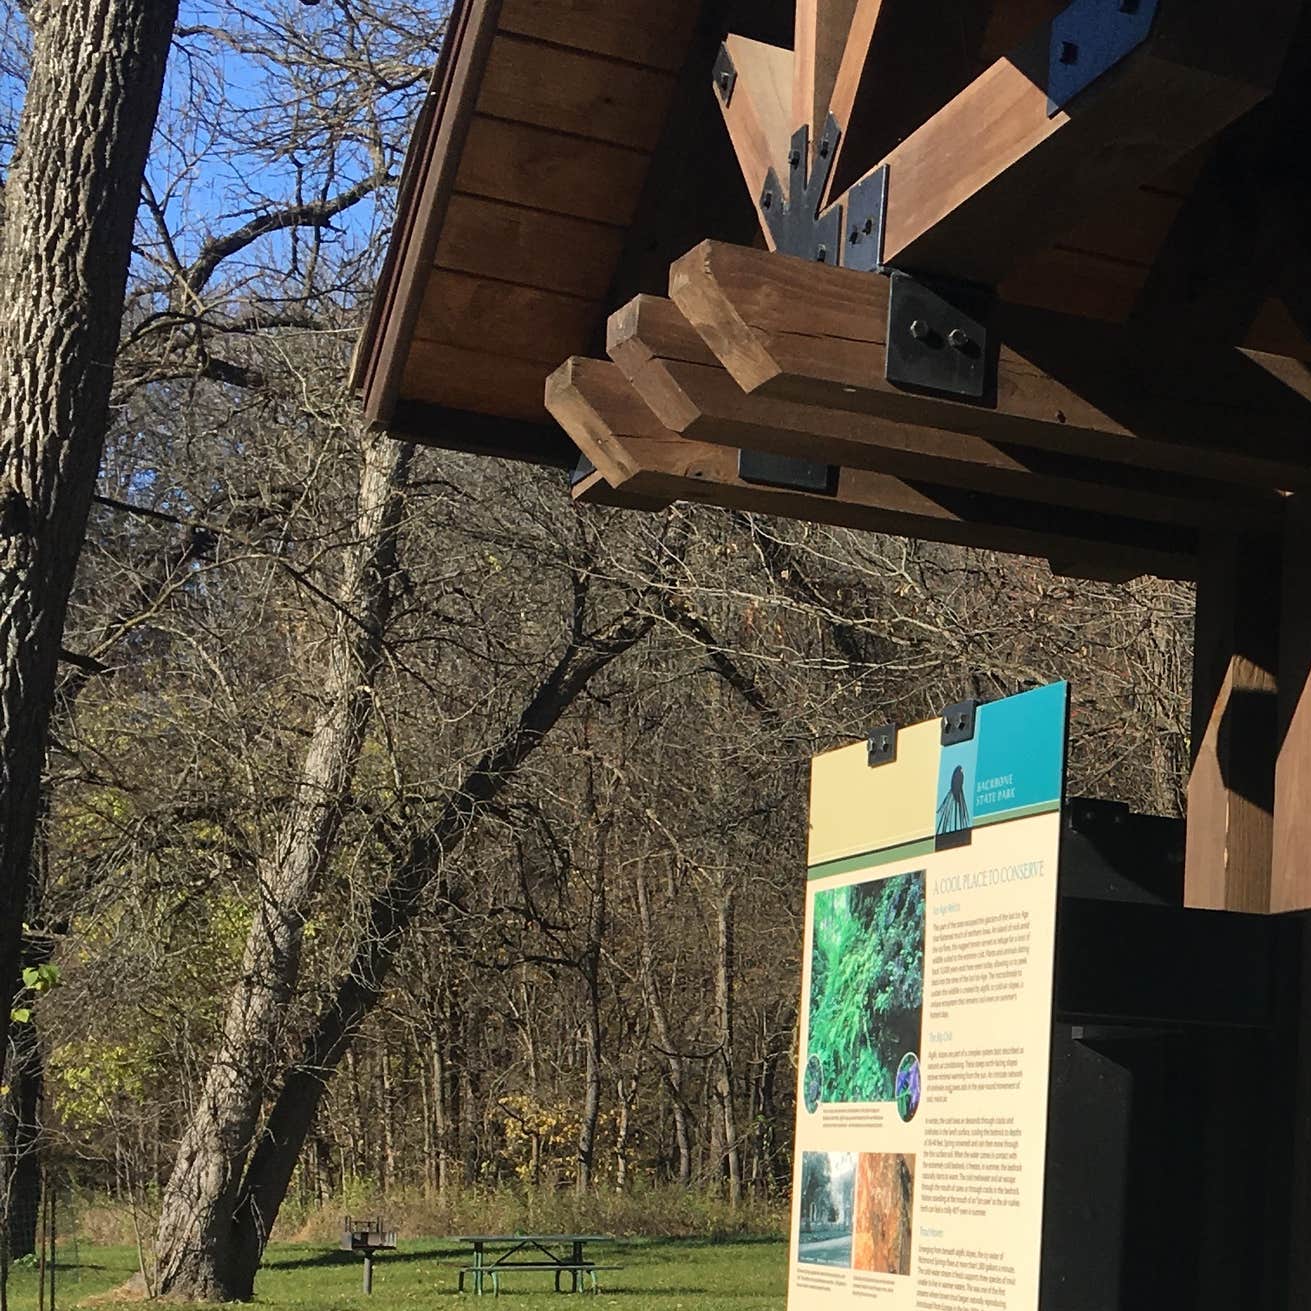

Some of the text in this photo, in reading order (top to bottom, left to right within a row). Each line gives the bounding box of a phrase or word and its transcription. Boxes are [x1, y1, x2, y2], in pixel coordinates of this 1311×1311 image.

[976, 774, 1012, 792] BACKBONE
[976, 786, 1015, 806] STATE PARK
